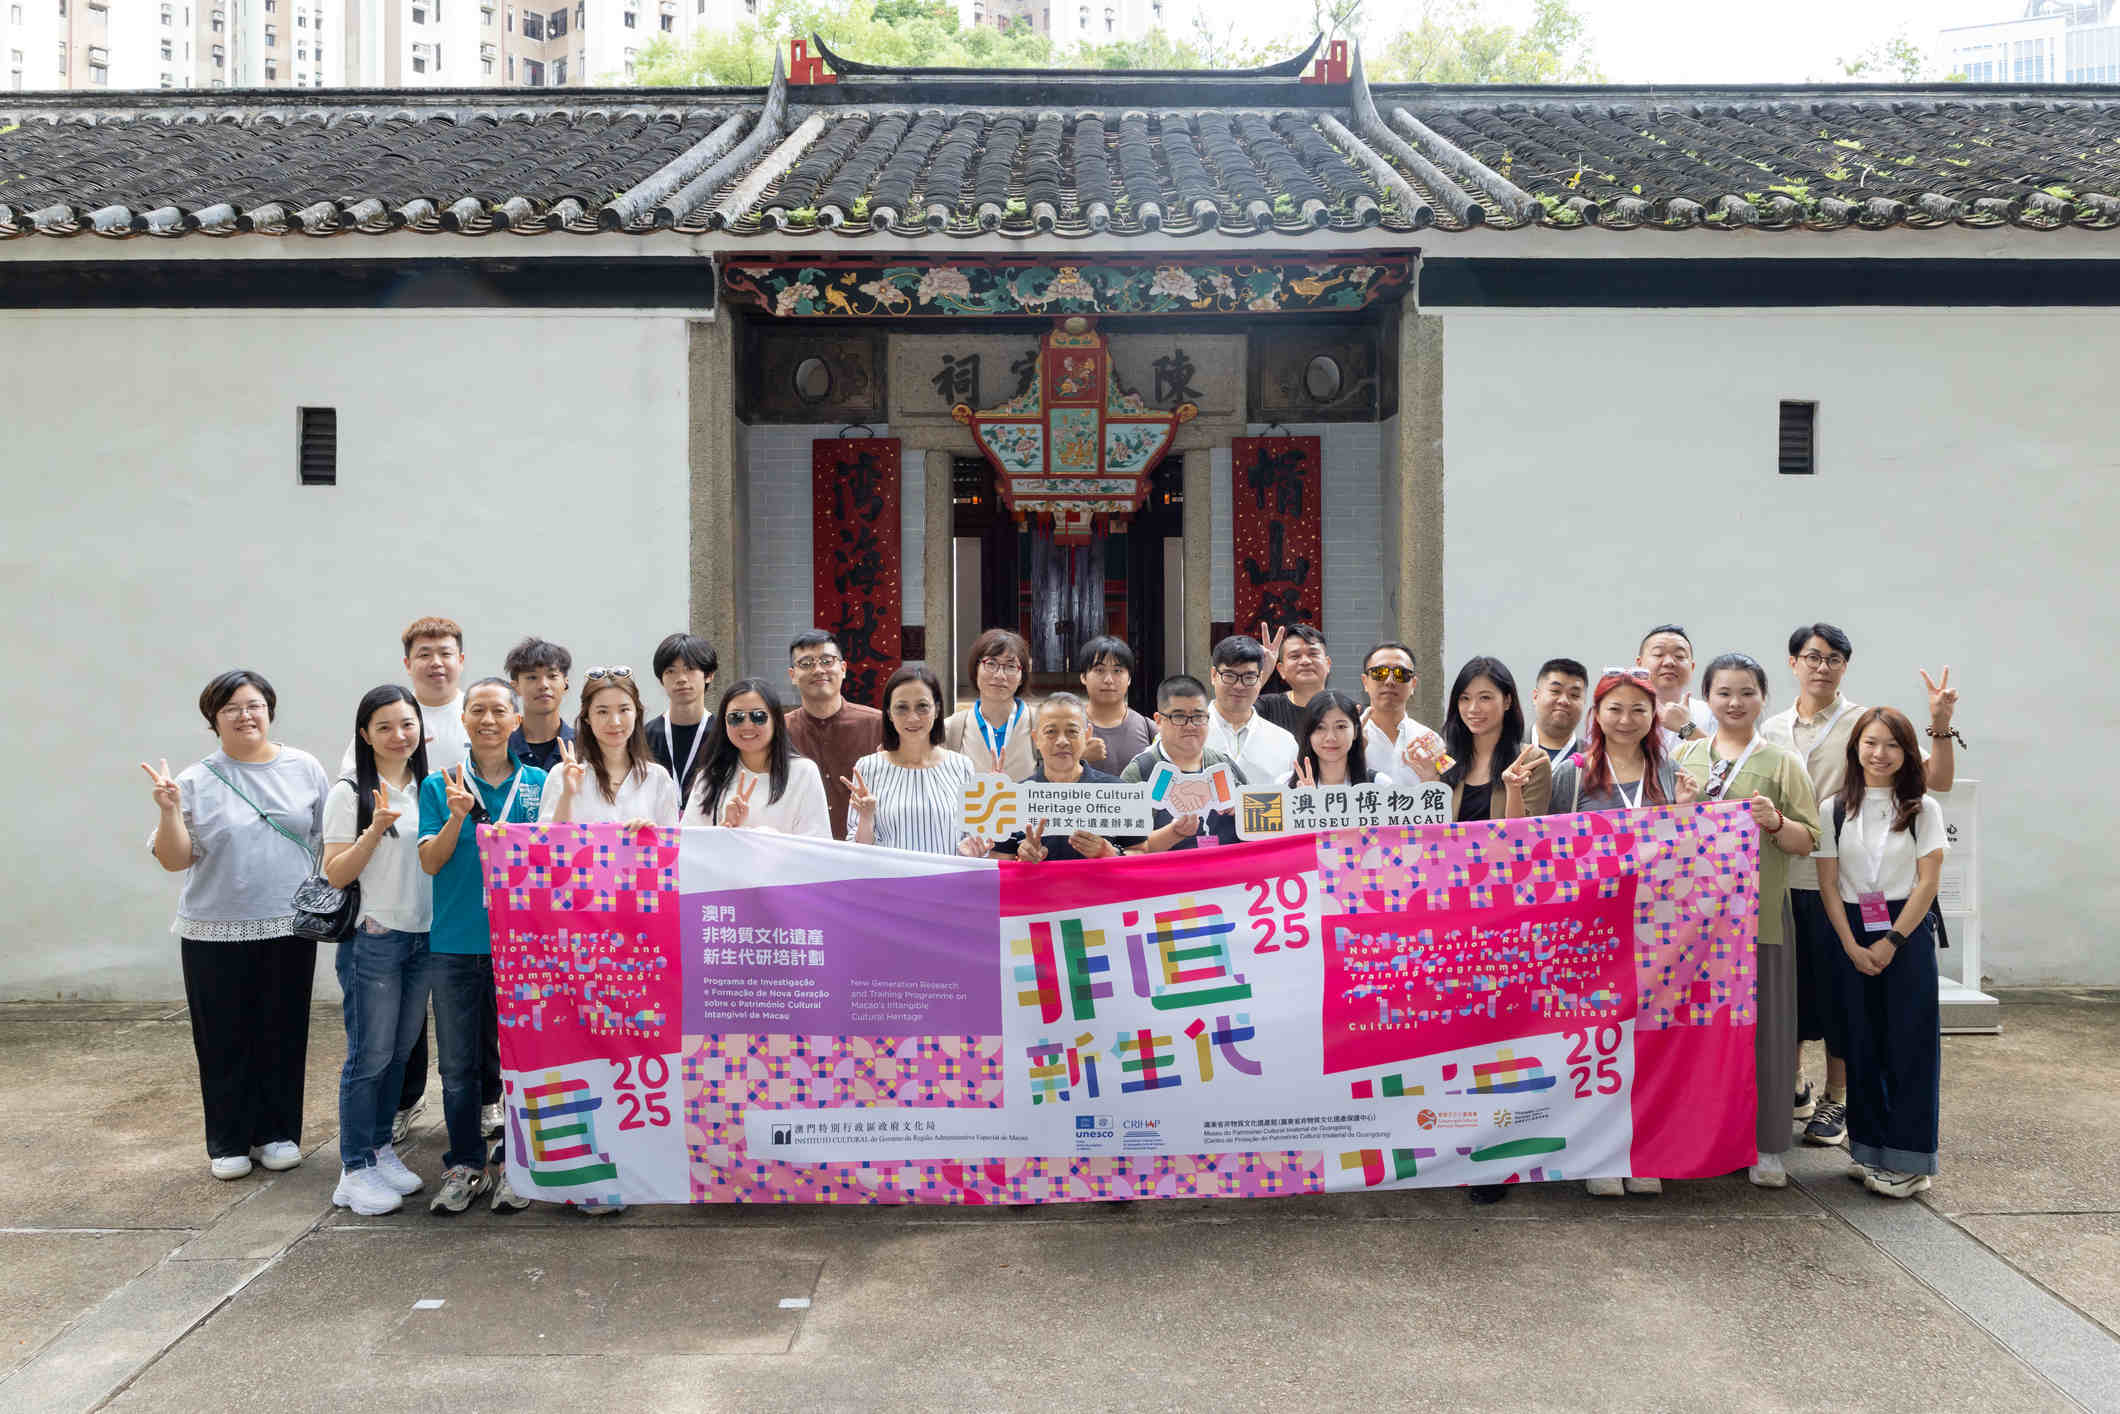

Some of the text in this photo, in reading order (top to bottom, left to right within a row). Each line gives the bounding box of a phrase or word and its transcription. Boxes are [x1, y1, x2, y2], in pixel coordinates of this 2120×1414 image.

[1028, 789, 1144, 801] Intangible Cultural
[1292, 789, 1446, 815] 澳門博物館
[1028, 803, 1121, 814] Heritage Office
[1294, 814, 1446, 829] MUSEU DE MACAU
[1244, 873, 1309, 917] 20
[702, 904, 736, 922] 澳門
[702, 926, 824, 945] 非物質文化遺產
[1251, 912, 1310, 955] 25
[1349, 926, 1615, 955] New Generation Research and
[703, 948, 824, 966] 新生代研培計劃
[1010, 896, 1252, 1024] 非遺
[1350, 968, 1419, 981] Training
[1428, 962, 1519, 976] Programme
[1527, 960, 1544, 968] on
[703, 976, 816, 988] Programa de Investigação
[704, 999, 728, 1008] sobre
[788, 1000, 821, 1009] Cultural
[712, 988, 754, 999] Formação
[770, 990, 792, 998] Nova
[794, 990, 830, 1000] Geração
[763, 1011, 790, 1020] Macau
[1349, 1008, 1618, 1031] Cultural Heritage
[1563, 1022, 1622, 1066] 20
[1026, 1013, 1262, 1105] 新生代
[609, 1054, 669, 1091] 20
[1569, 1056, 1622, 1099] 25
[616, 1091, 671, 1131] 25
[832, 1136, 868, 1145] CULTURAL
[1076, 1130, 1114, 1138] unesco
